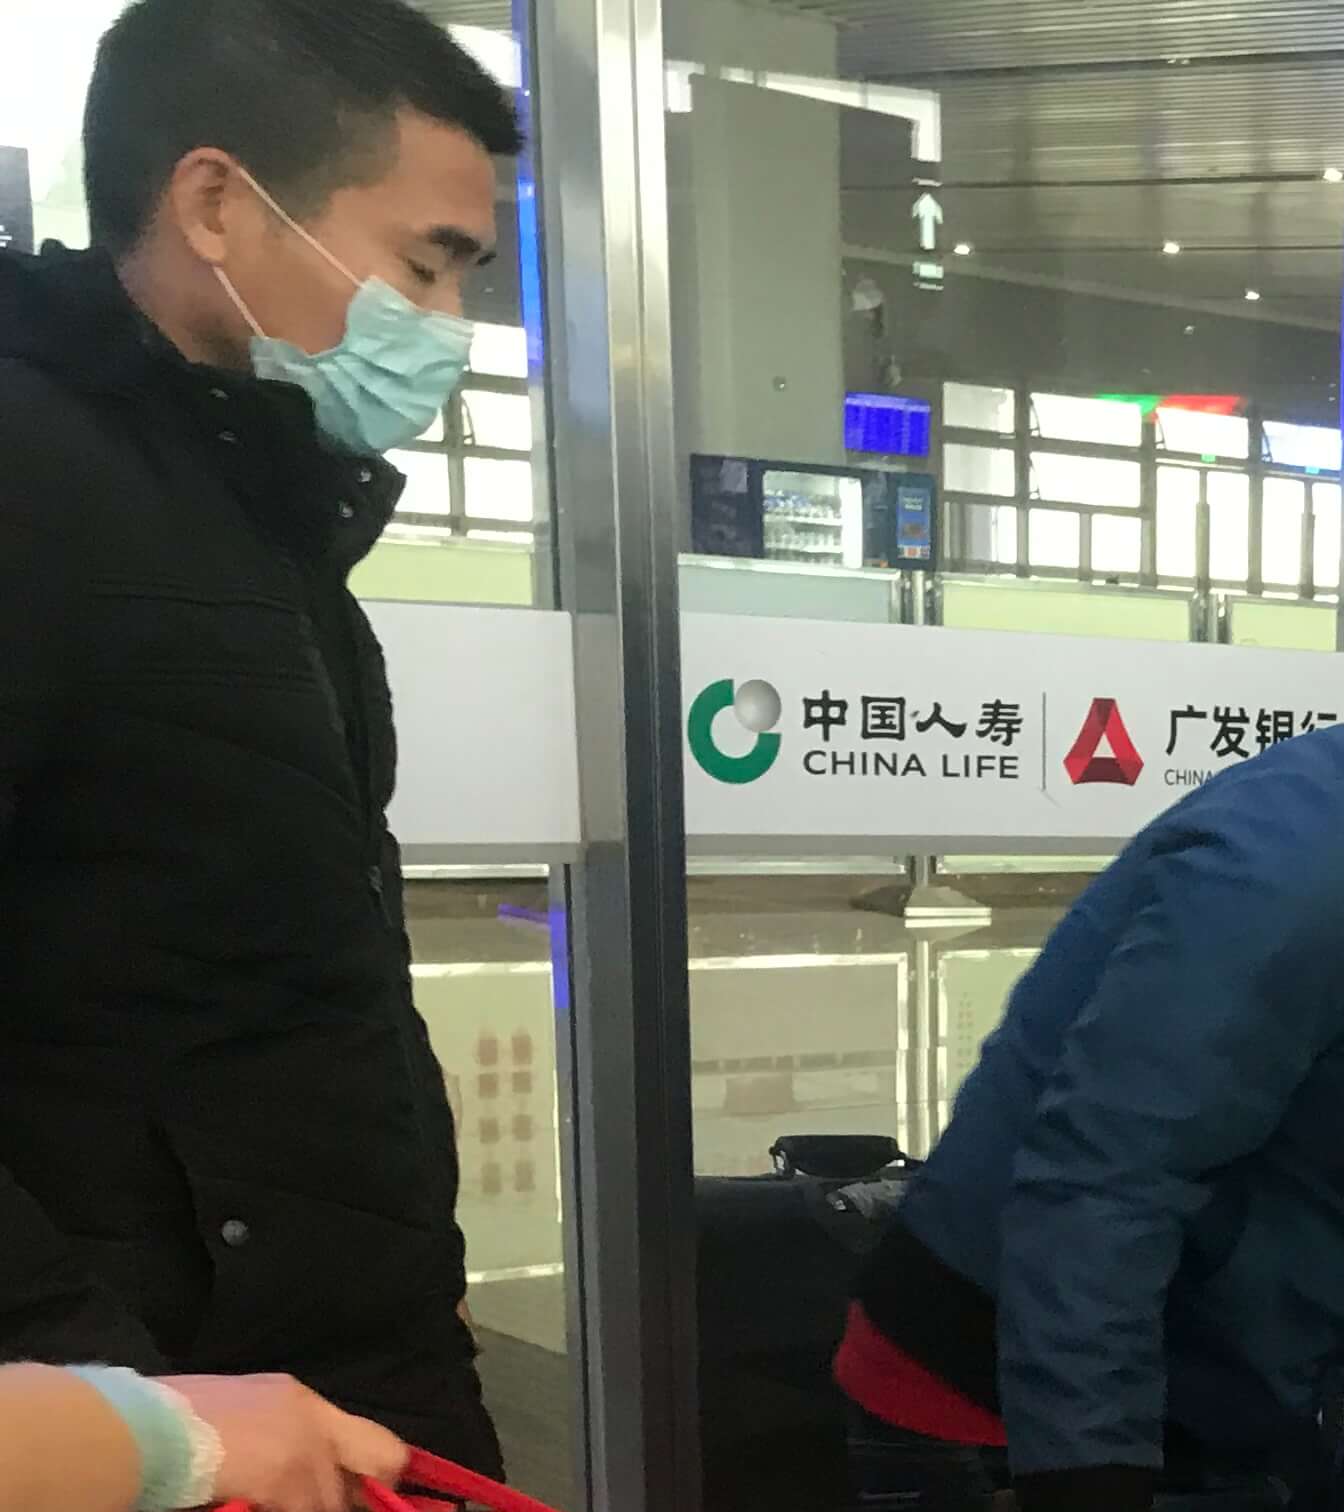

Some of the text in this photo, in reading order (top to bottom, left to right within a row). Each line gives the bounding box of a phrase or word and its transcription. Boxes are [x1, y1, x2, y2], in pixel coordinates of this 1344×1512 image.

[803, 689, 1024, 747] 中国人寿
[803, 750, 1019, 779] CHINA LIFE
